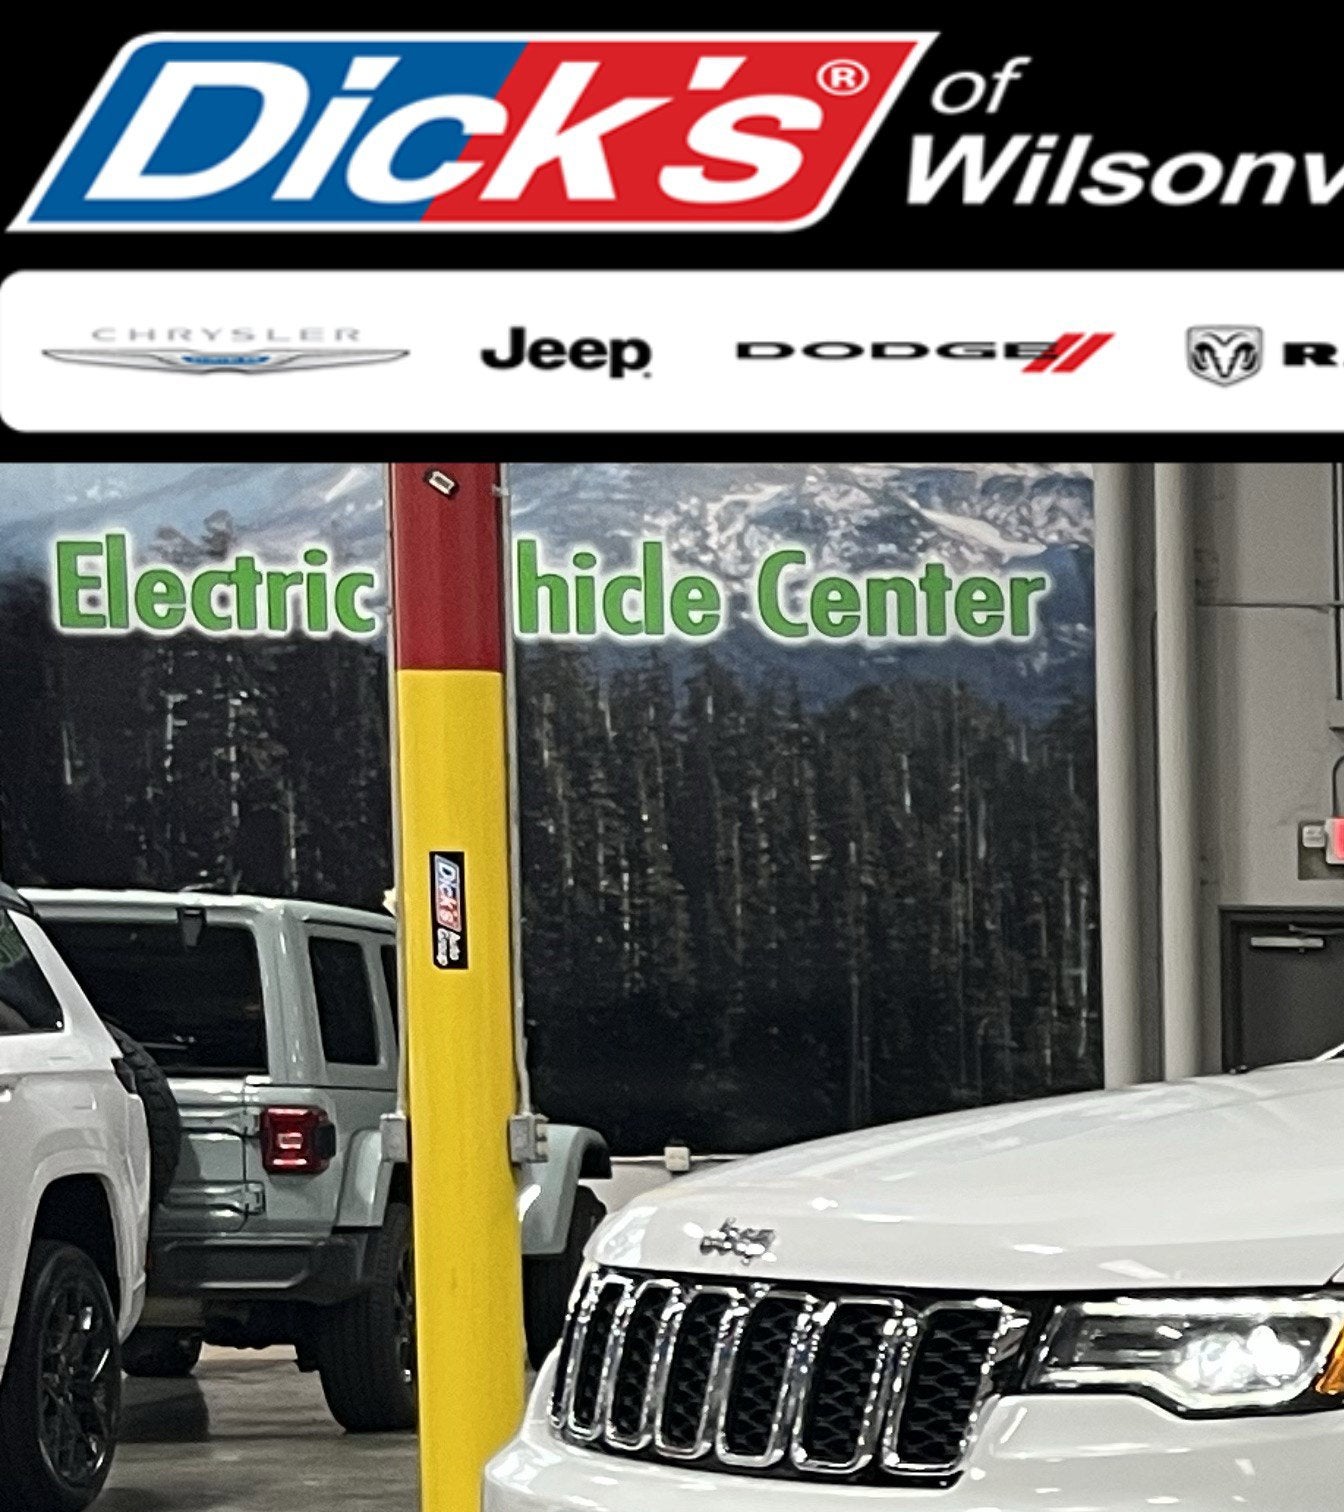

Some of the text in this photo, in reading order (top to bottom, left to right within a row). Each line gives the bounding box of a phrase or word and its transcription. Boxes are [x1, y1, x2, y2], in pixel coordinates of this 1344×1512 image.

[57, 534, 1046, 637] Electric hicle Center
